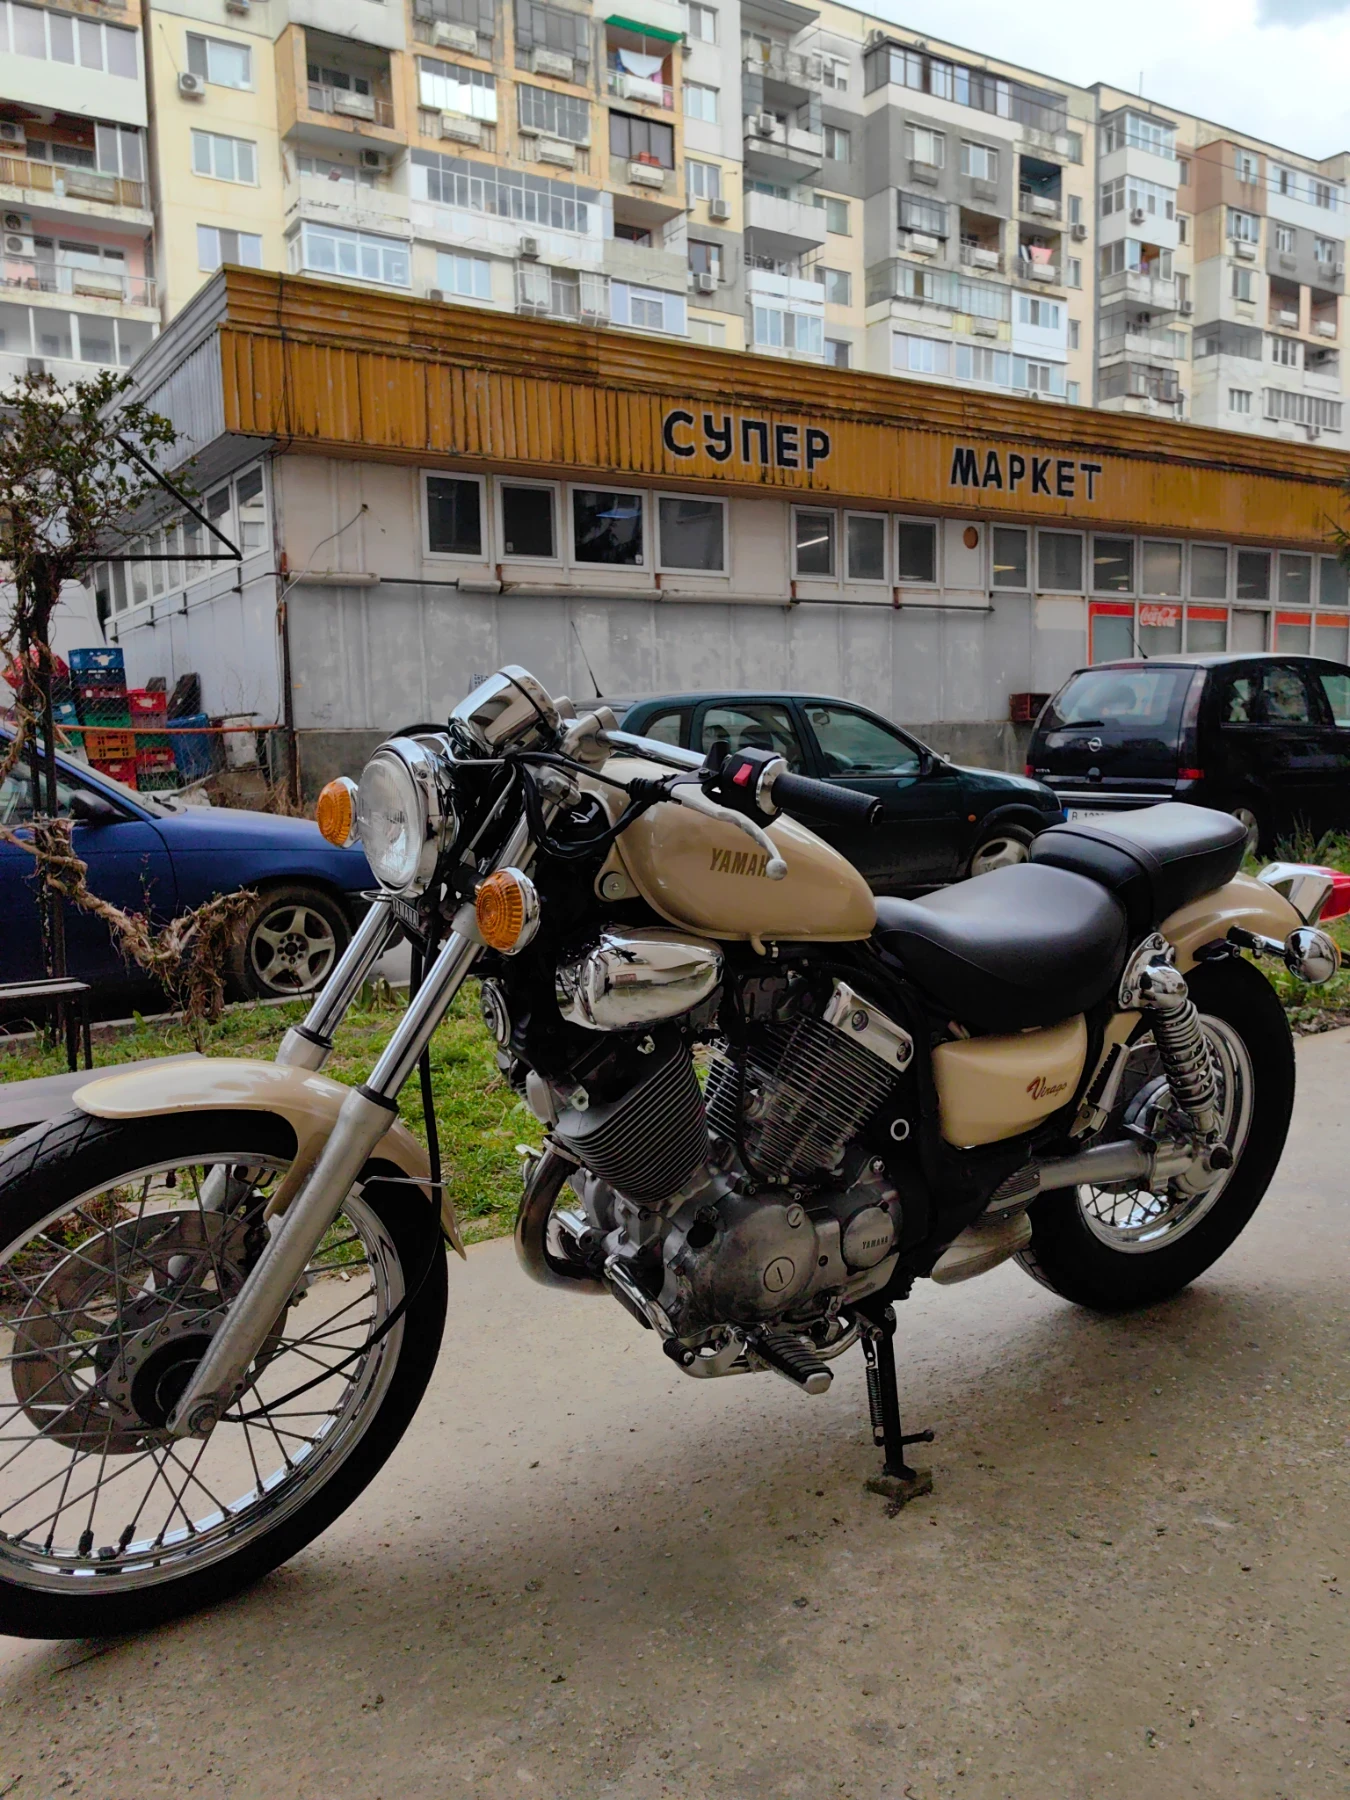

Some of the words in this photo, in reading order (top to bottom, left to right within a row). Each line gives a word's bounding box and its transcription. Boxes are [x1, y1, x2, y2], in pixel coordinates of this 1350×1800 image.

[663, 410, 830, 470] СУПЕР
[950, 447, 1103, 501] МАРКЕТ
[709, 847, 773, 878] YAMAH
[1026, 1076, 1068, 1101] Virago
[862, 1235, 889, 1250] YAMAHA
